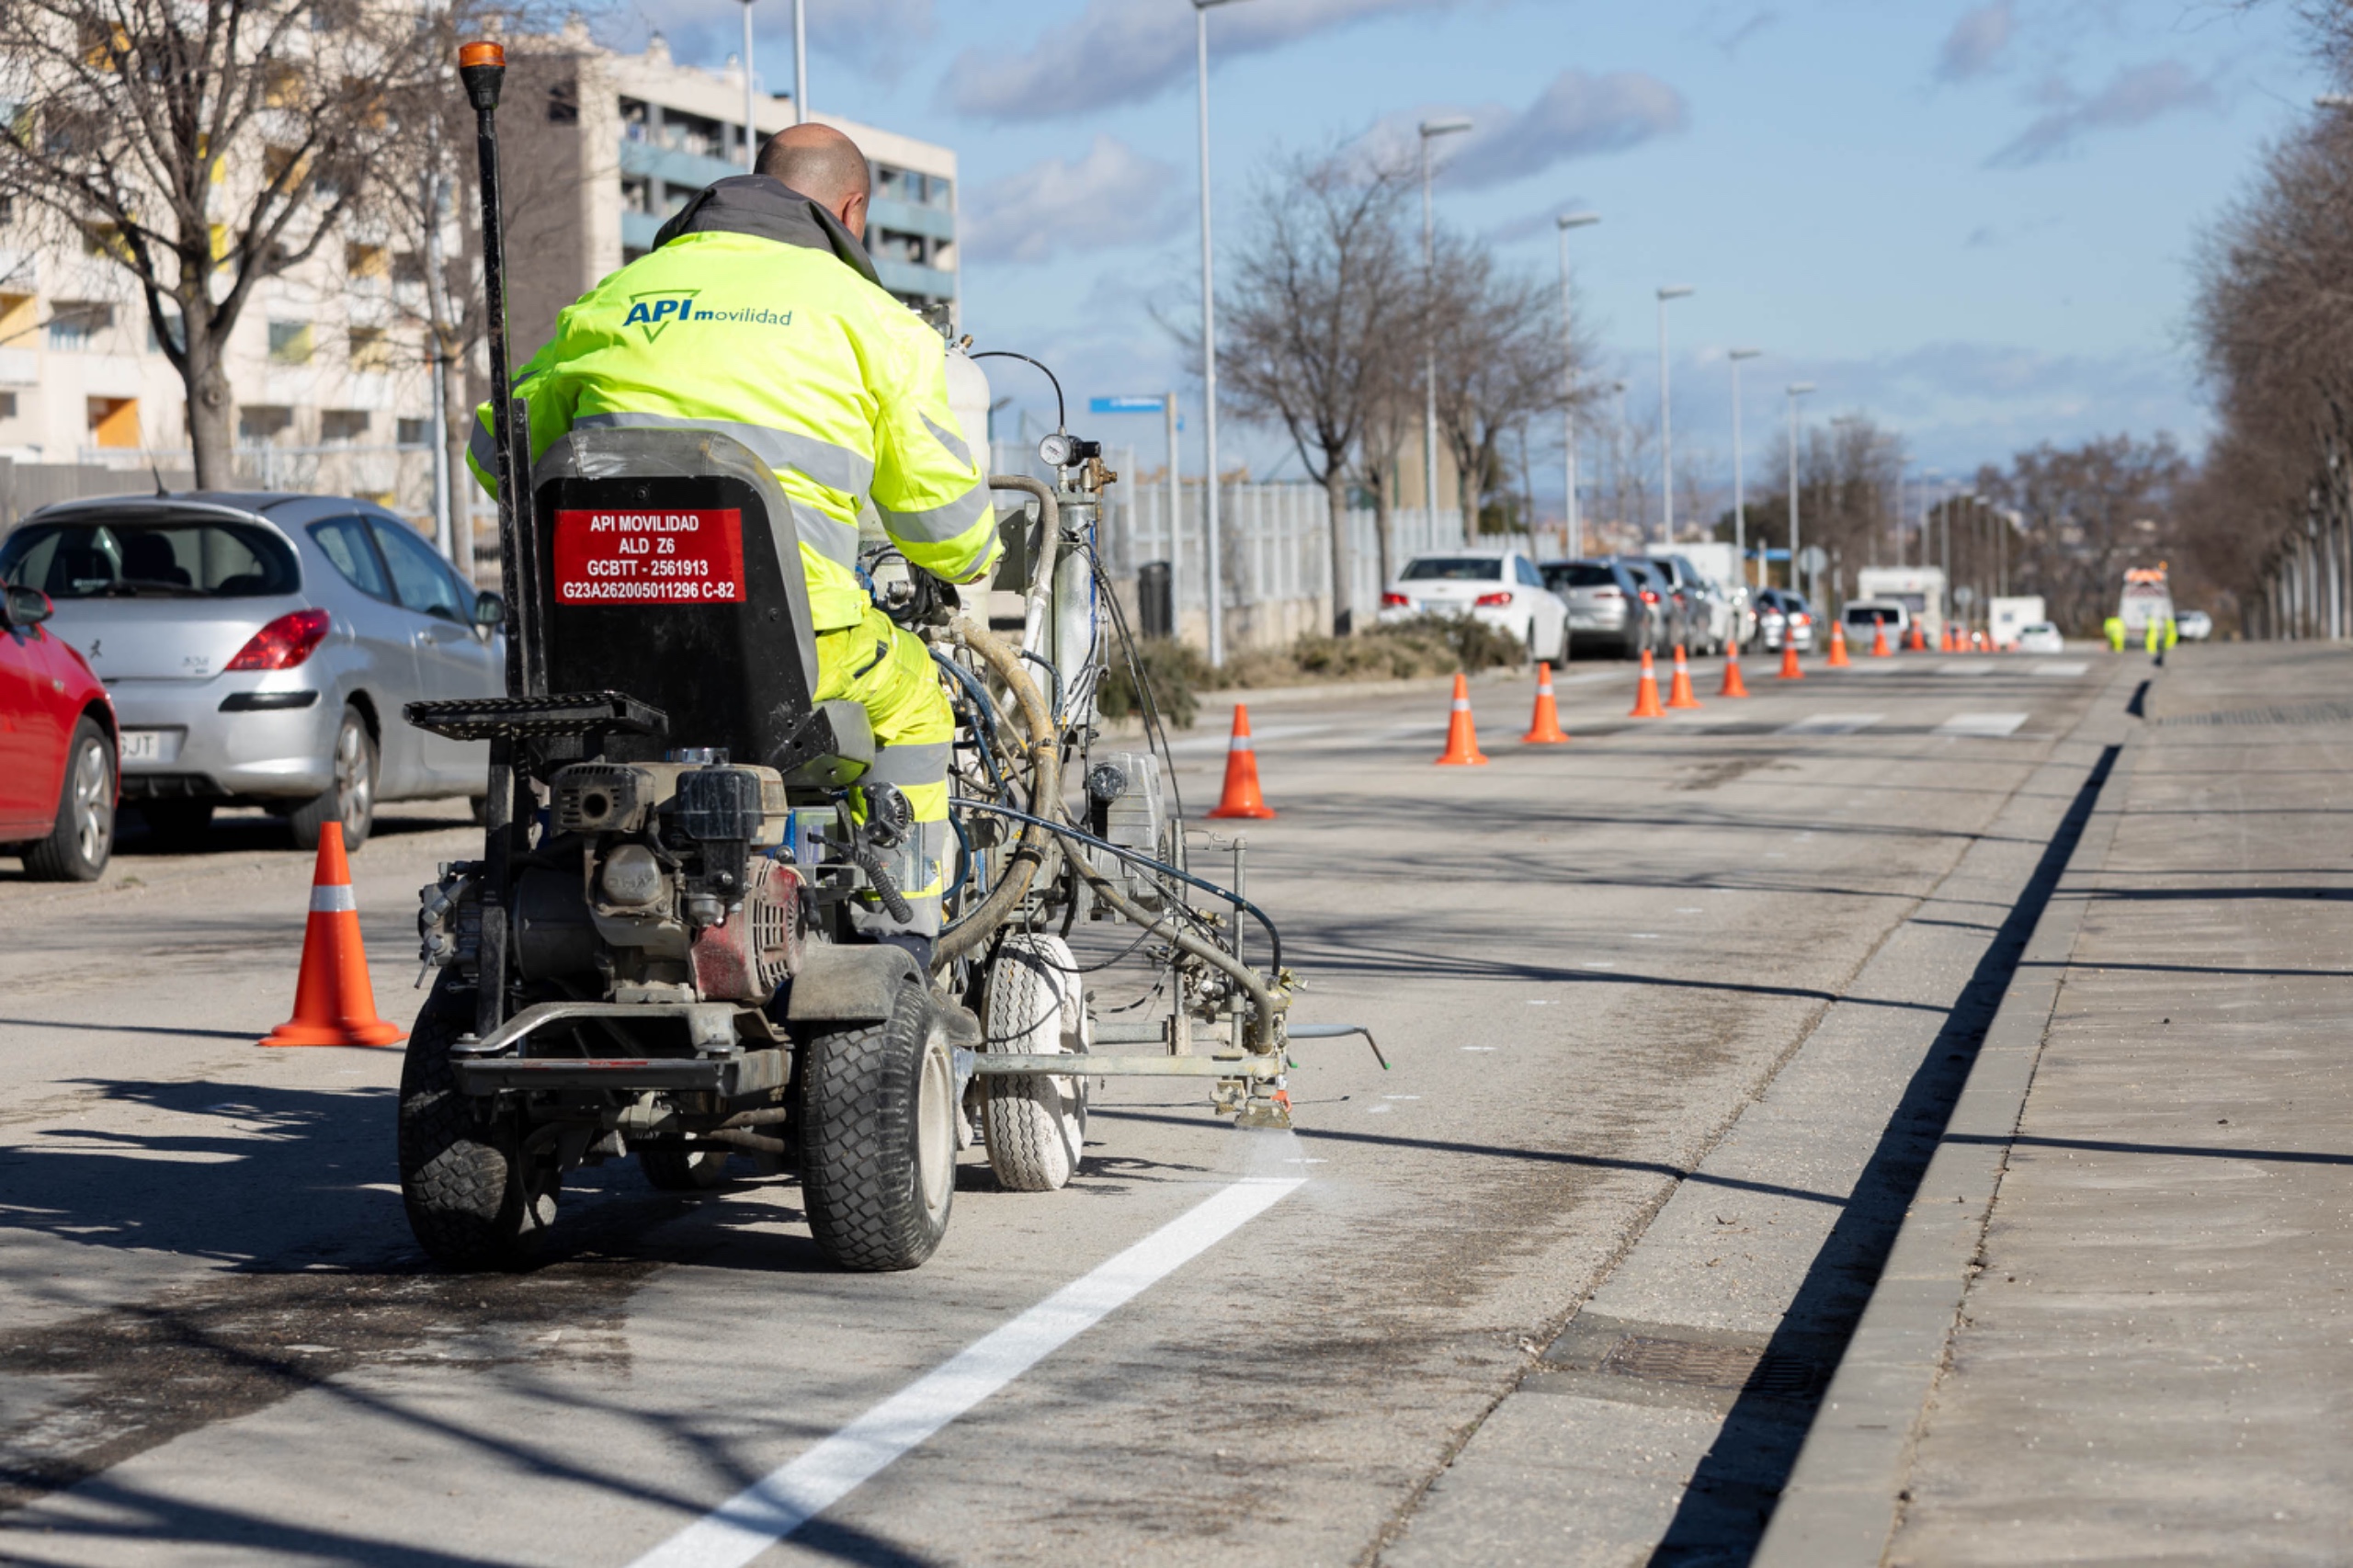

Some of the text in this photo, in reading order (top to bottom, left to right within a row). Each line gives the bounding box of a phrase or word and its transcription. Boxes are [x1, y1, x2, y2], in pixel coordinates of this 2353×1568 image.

[622, 299, 792, 327] API movilidad
[590, 515, 699, 532] API MOVILIDAD
[619, 537, 676, 554] ALD Z6
[586, 559, 639, 576] GCBTT
[650, 559, 709, 576] 2561913
[563, 581, 735, 598] G23A262005011296 C-82
